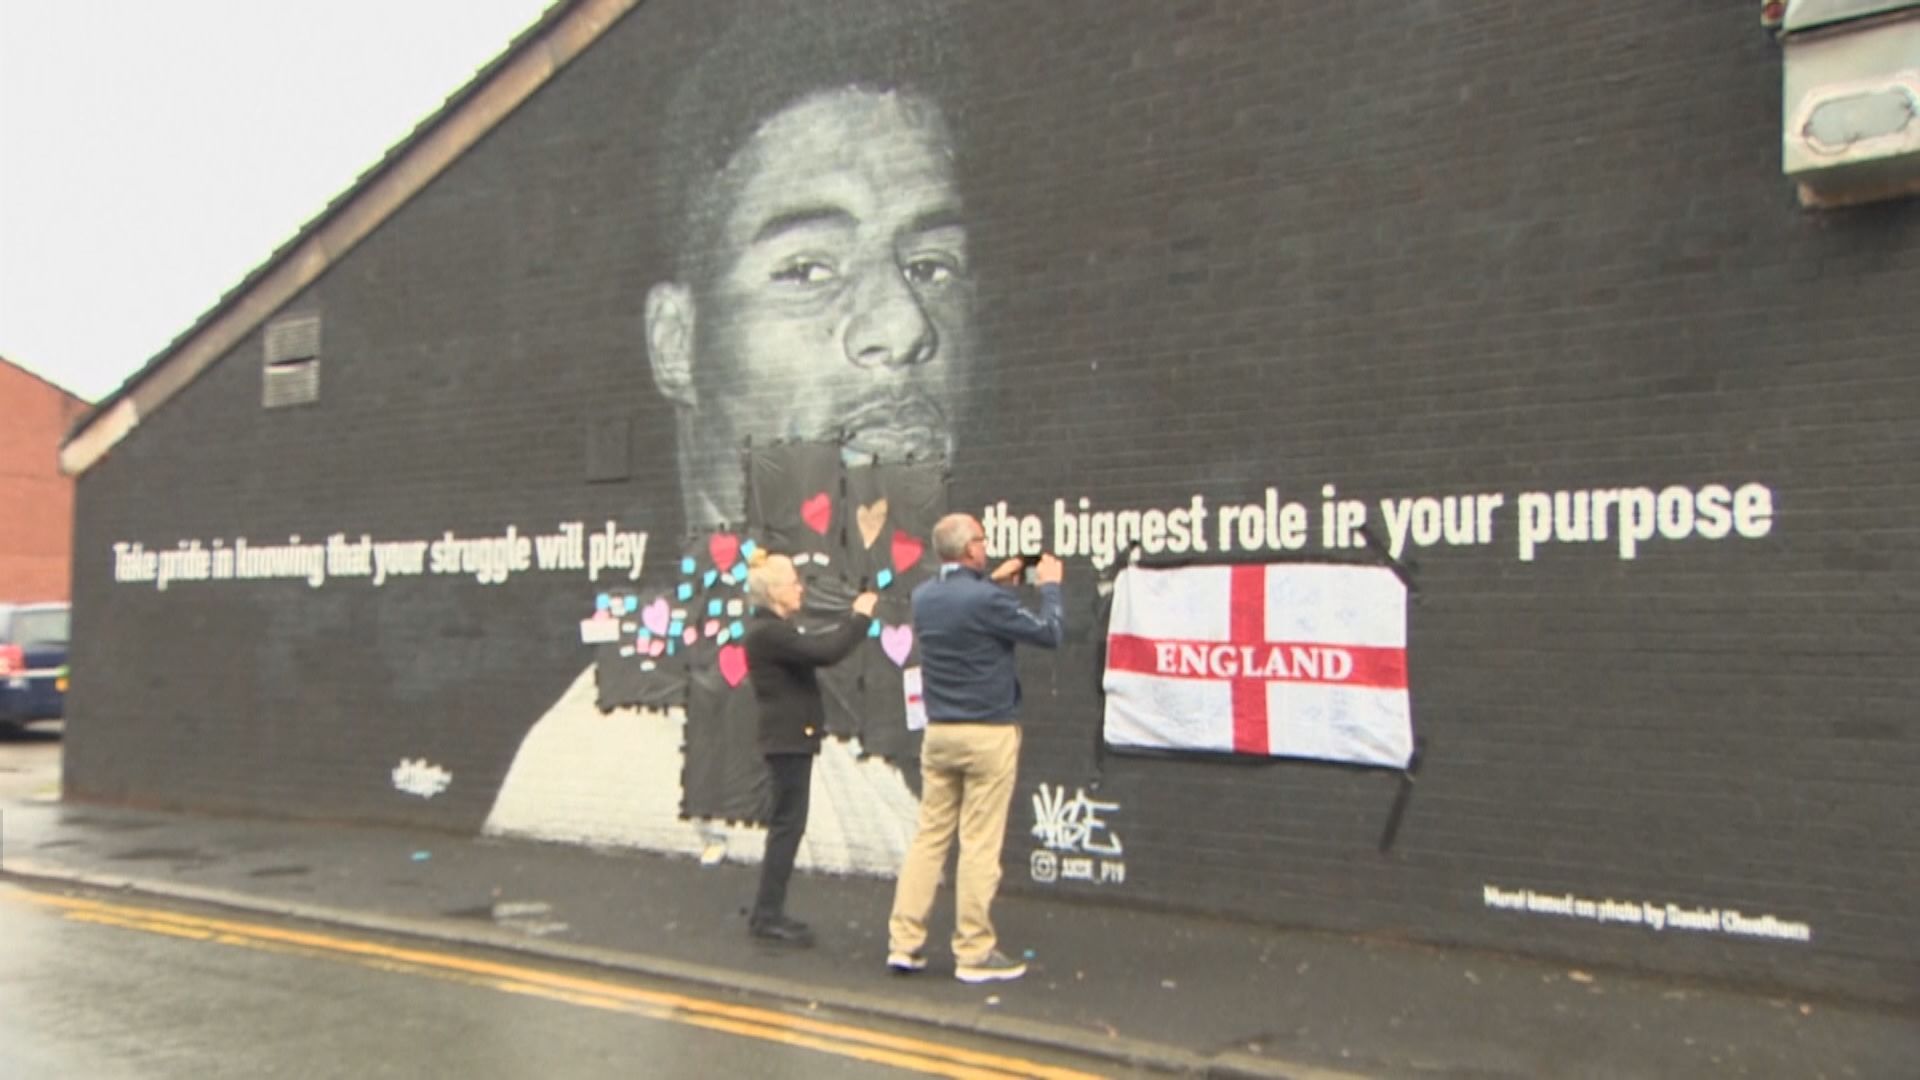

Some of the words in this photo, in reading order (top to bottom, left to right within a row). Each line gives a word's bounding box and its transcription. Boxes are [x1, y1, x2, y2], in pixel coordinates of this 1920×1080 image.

[984, 501, 1043, 558] the
[1053, 496, 1207, 568] biggest
[1218, 486, 1307, 552] role
[1322, 484, 1367, 549] in
[1380, 493, 1503, 560] your
[1517, 483, 1773, 561] purpose
[113, 542, 157, 582] Take
[157, 539, 210, 591] pride
[212, 538, 234, 579] in
[235, 536, 325, 588] knowing
[327, 532, 371, 577] that
[373, 541, 428, 586] your
[430, 525, 531, 584] struggle
[535, 522, 584, 570] will
[588, 520, 648, 581] play
[1154, 641, 1354, 681] ENGLAND
[1643, 902, 1665, 931] by
